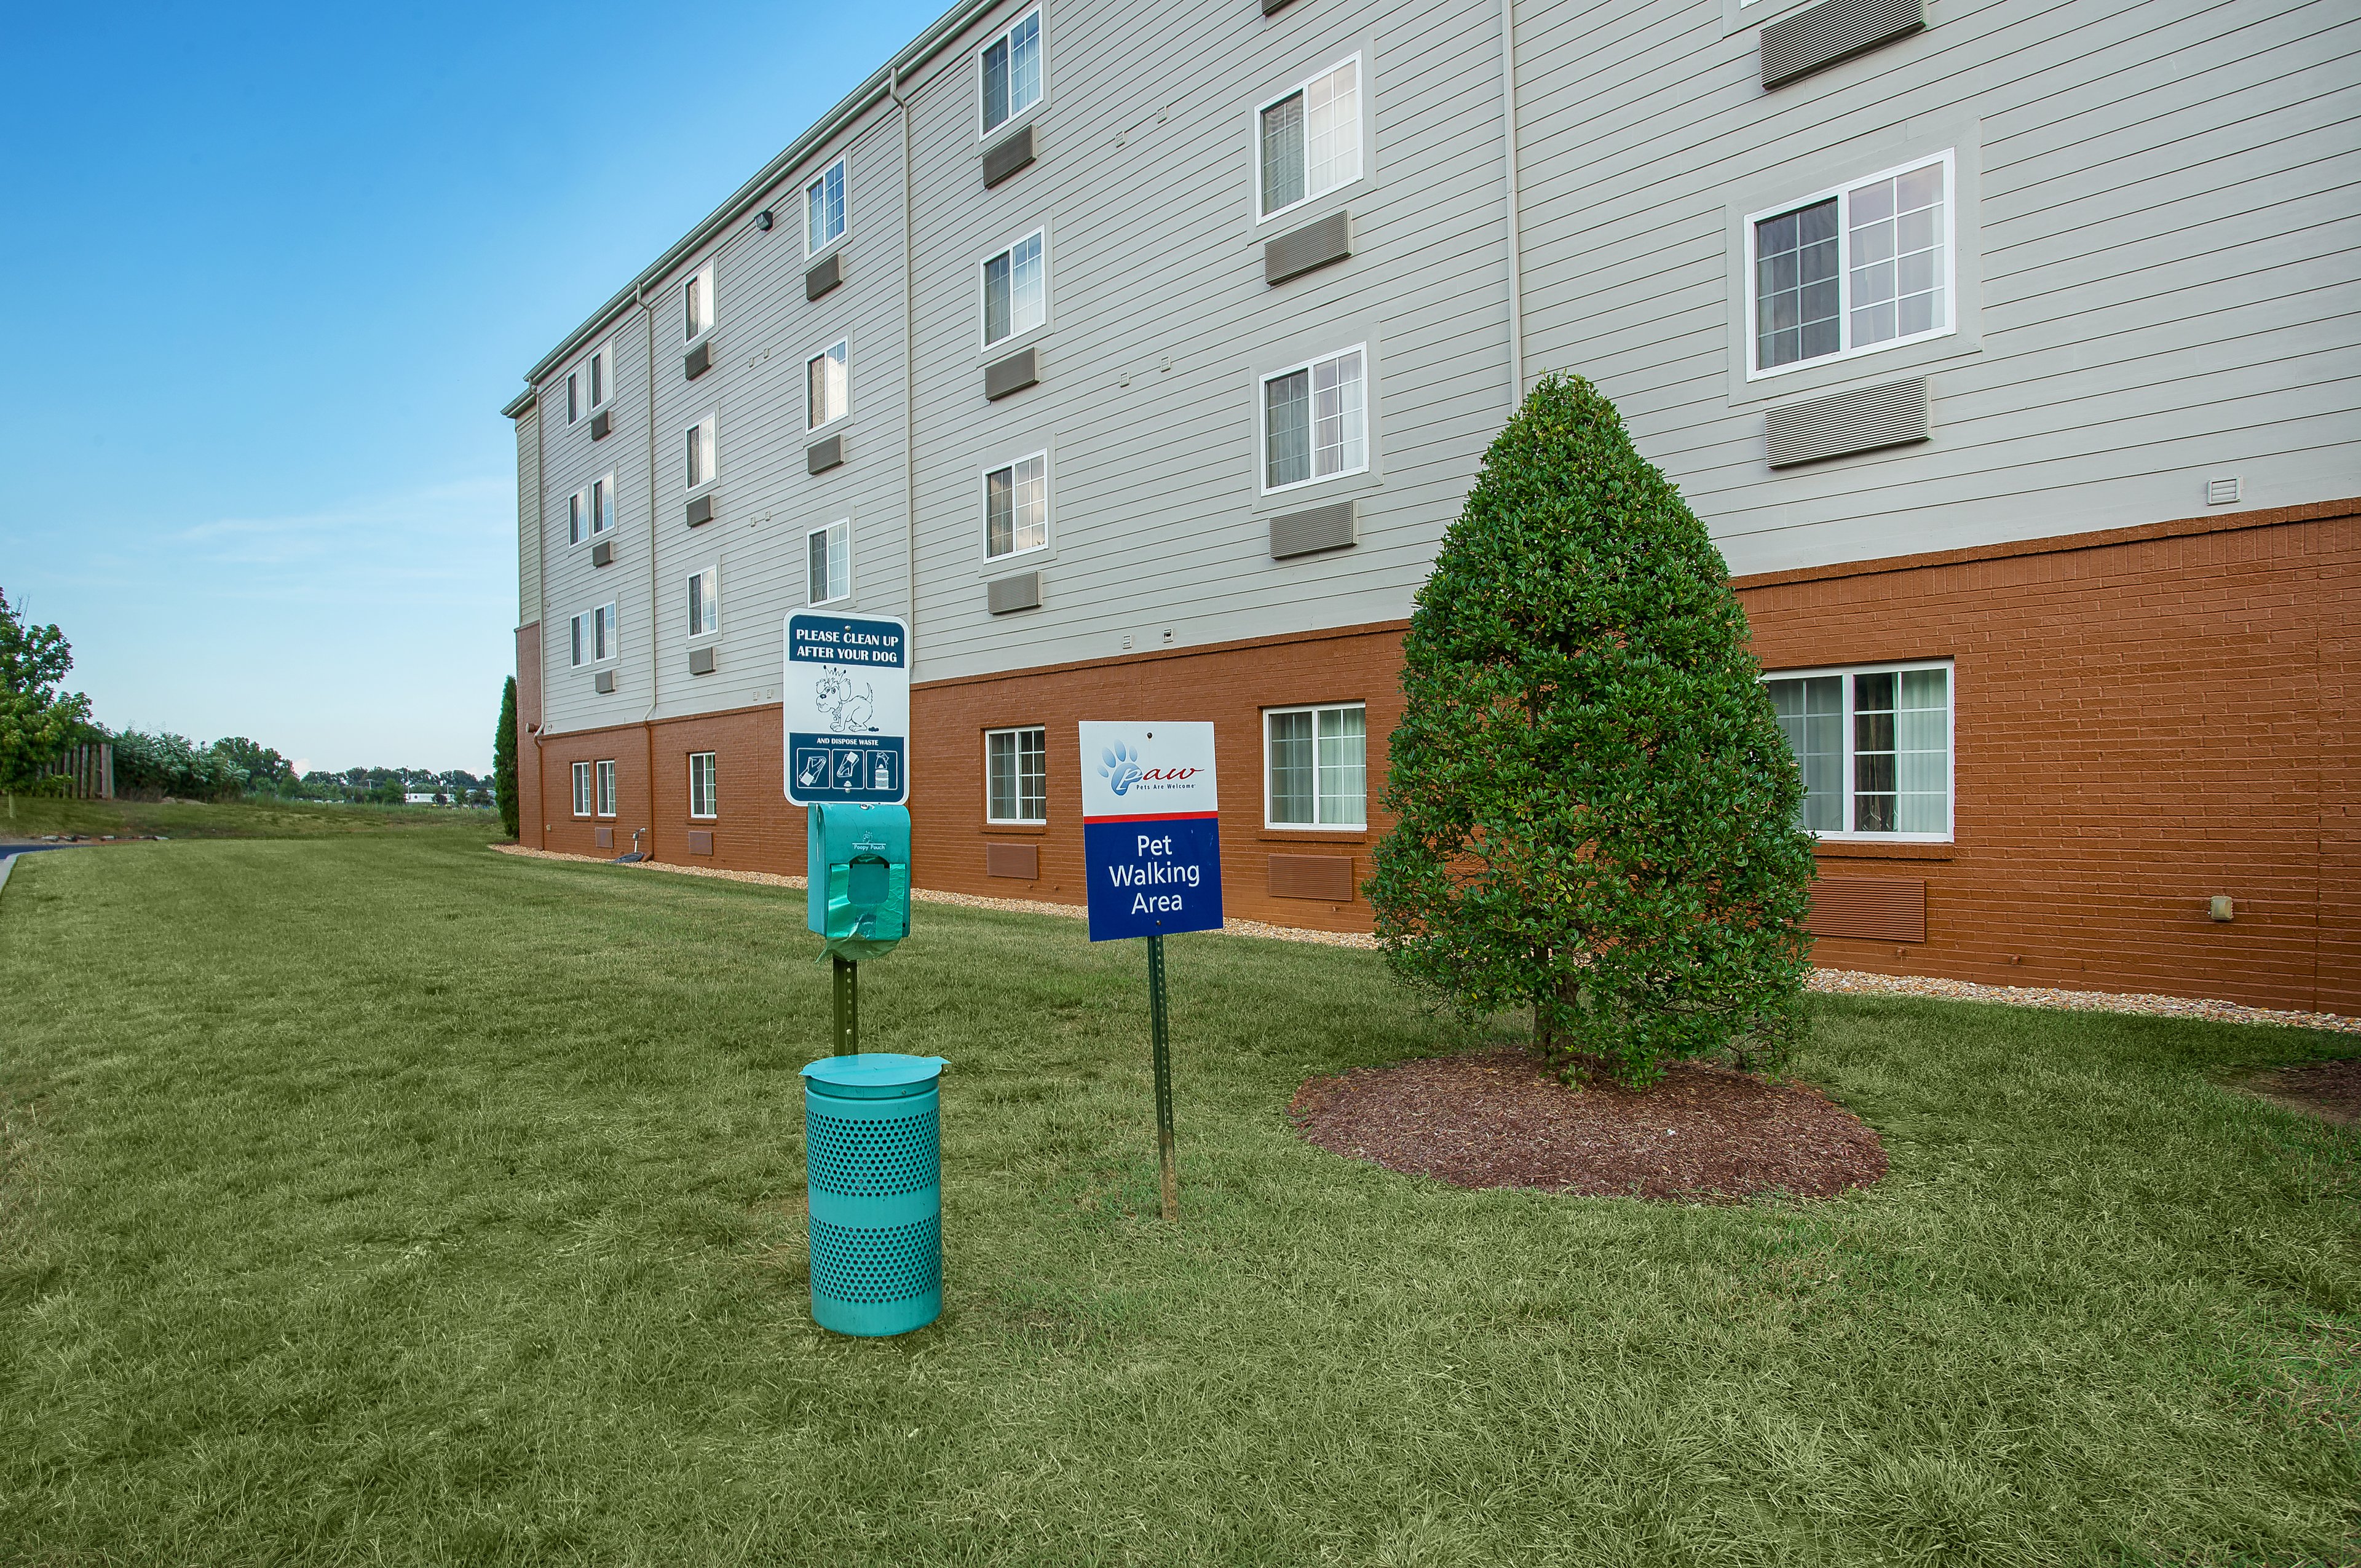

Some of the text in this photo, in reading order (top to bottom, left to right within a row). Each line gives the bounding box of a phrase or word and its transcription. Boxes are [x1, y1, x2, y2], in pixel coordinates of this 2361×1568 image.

[796, 629, 898, 647] PLEASE CLEAN UP
[797, 645, 897, 662] AFTER YOUR DOG
[1137, 834, 1173, 857] Pet
[1108, 861, 1200, 887] Walking
[1131, 892, 1183, 914] Area
